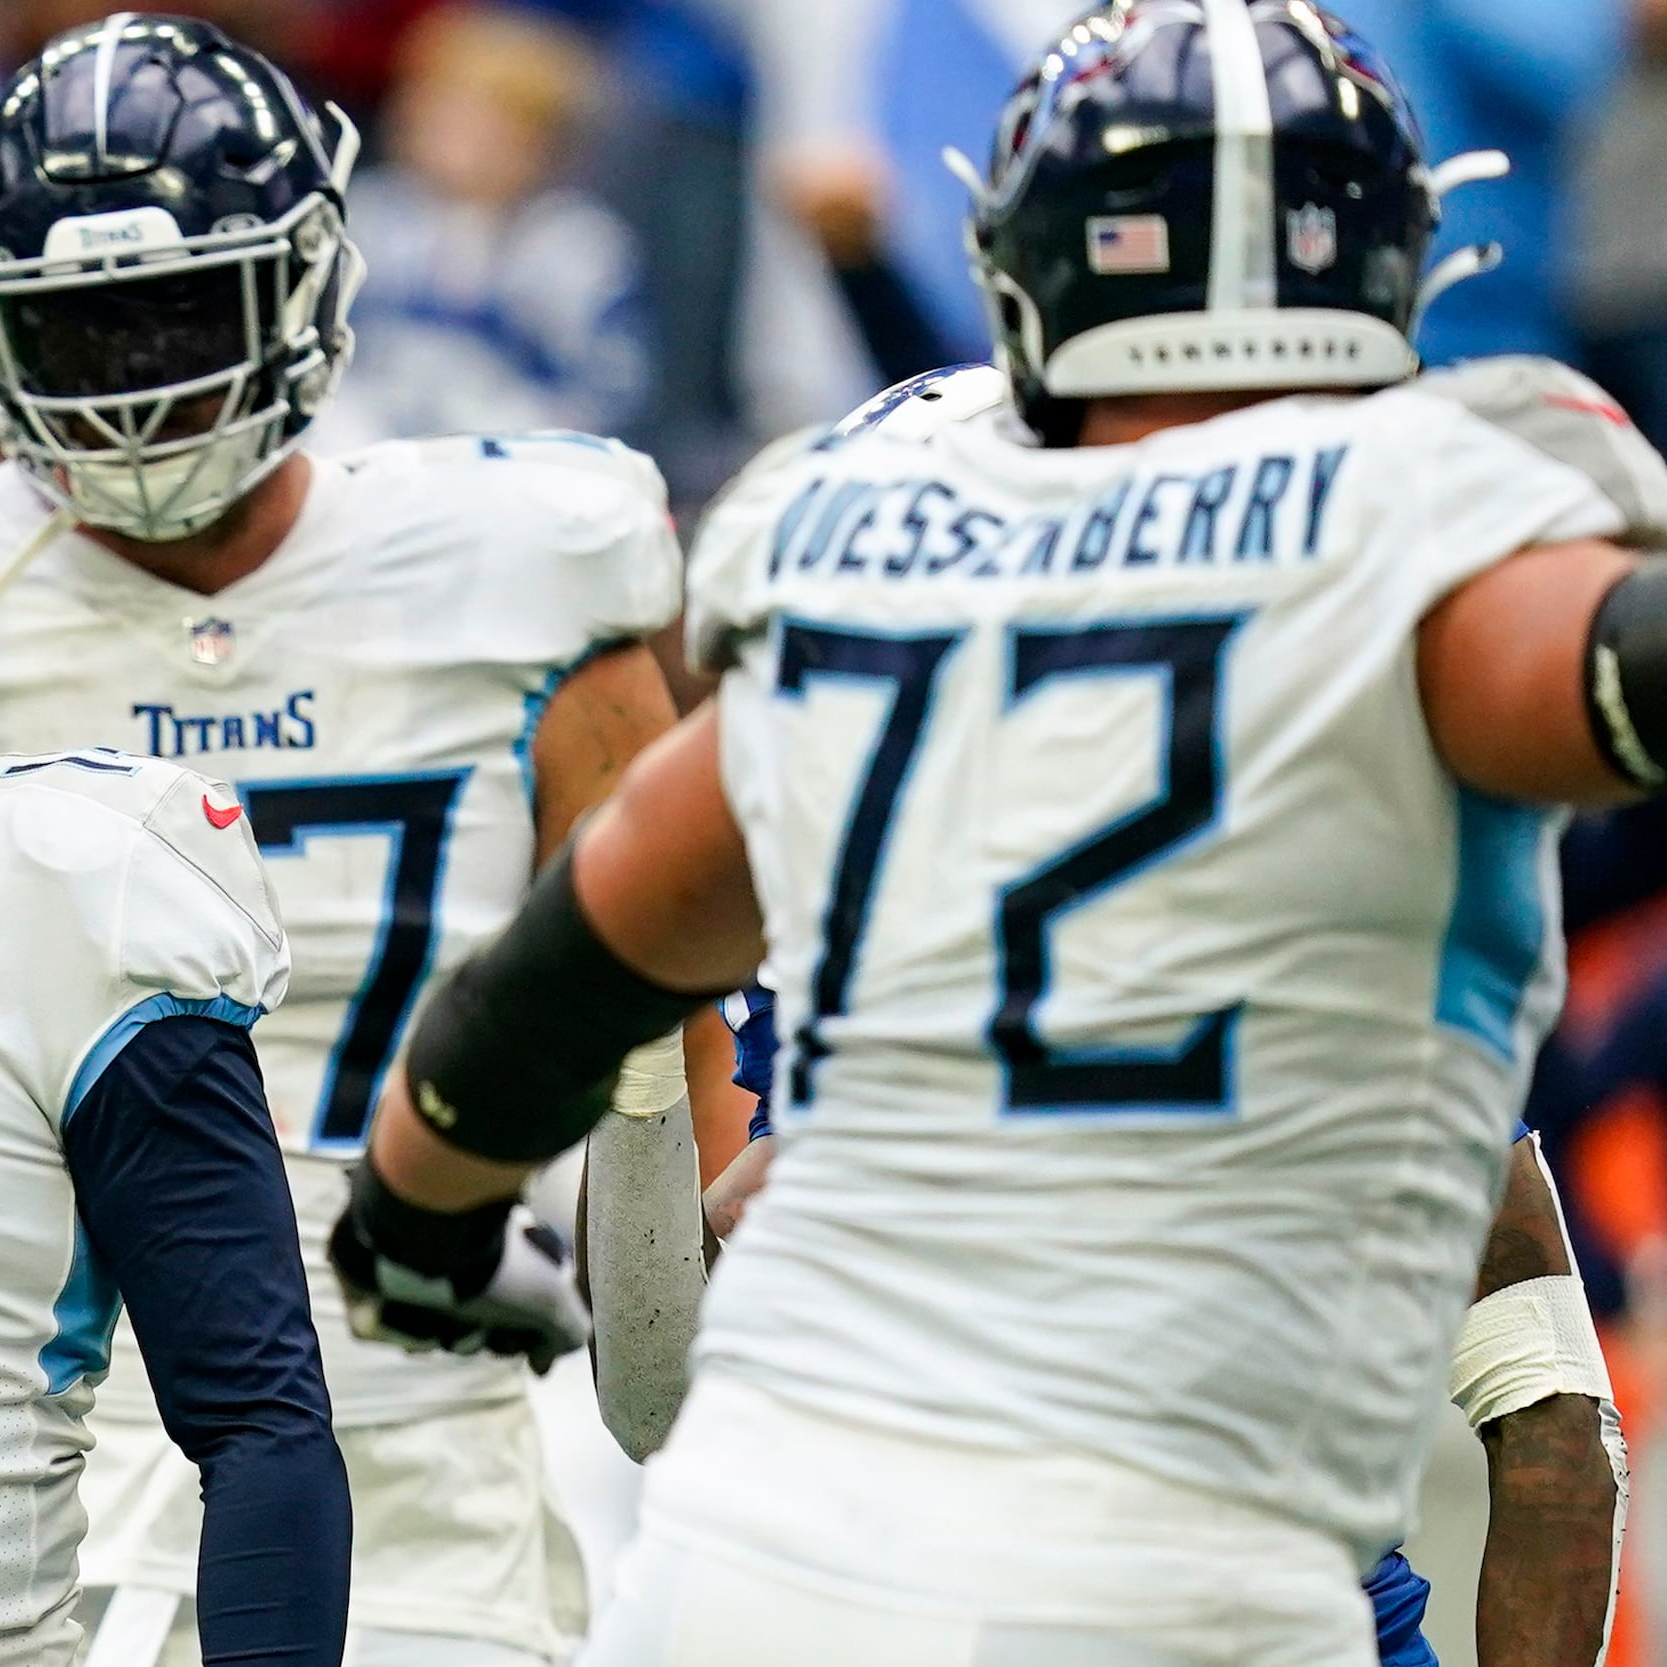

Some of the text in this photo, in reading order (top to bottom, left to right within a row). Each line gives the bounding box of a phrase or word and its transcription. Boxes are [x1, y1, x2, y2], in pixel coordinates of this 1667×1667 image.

[767, 445, 1348, 579] UESSNBERRY
[131, 690, 315, 757] TITANS
[771, 606, 1258, 1120] 72
